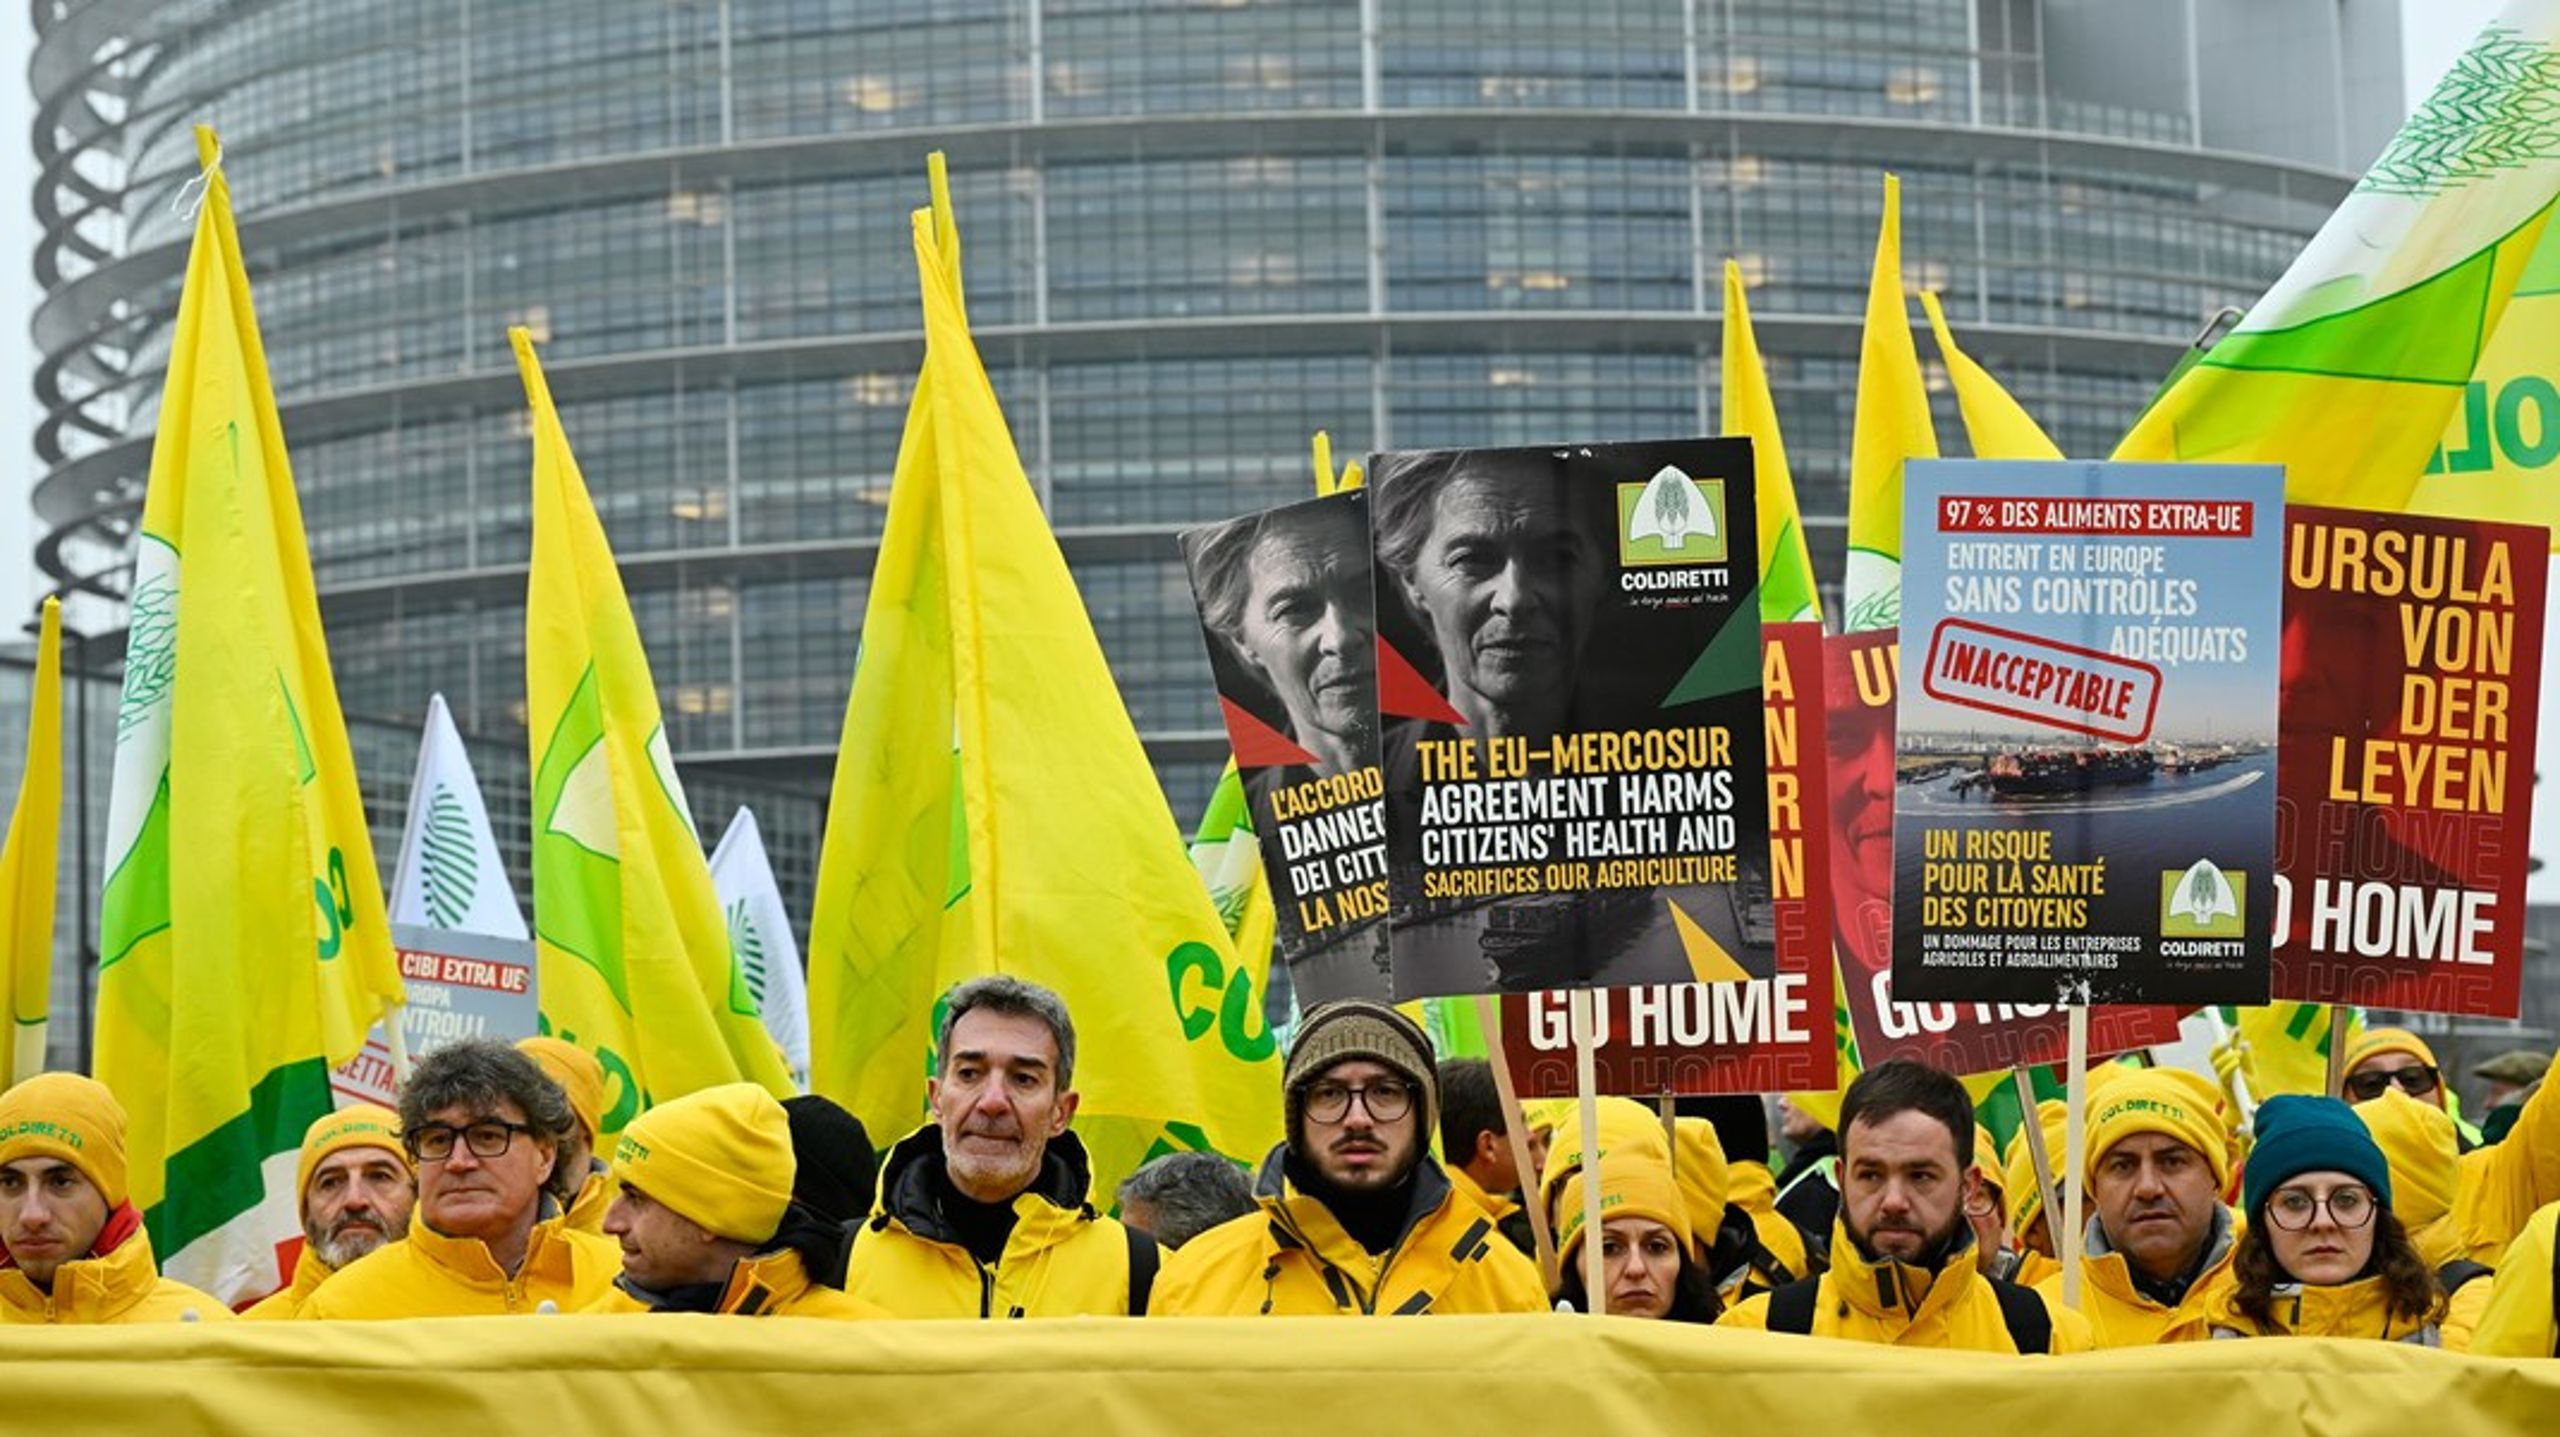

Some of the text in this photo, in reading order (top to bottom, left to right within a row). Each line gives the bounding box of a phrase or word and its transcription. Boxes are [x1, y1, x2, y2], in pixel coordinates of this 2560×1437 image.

[1946, 500, 2242, 532] 97 % DES ALIMENTS EXTRA-UE
[1621, 568, 1729, 591] COLDIRETTI
[1948, 542, 2165, 575] ENTRENT EN EUROPE
[2289, 522, 2516, 607] URSULA
[1944, 569, 2198, 617] SANS CONTRÔLES
[2108, 616, 2249, 668] ADÉQUATS
[2400, 602, 2516, 676] VON
[1940, 639, 2136, 721] INACCEPTABLE
[2400, 673, 2510, 744] DER
[1415, 739, 1478, 782] THE
[2329, 735, 2509, 815] LEYEN
[1269, 765, 1384, 822] L'ACCORD
[1420, 769, 1735, 826] AGREEMENT HARMS
[1421, 814, 1736, 866] CITIZENS' HEALTH AND
[1924, 829, 2052, 863] UN RISQUE
[1289, 858, 1332, 897] DEI
[1424, 854, 1738, 898] SACRIFICES OUR AGRICULTURE
[1923, 856, 2106, 896] POUR LA SANTÉ
[1299, 894, 1334, 933] LA
[1922, 896, 2088, 929] DES CITOYENS
[2310, 877, 2498, 966] HOME
[1921, 950, 2119, 969] AGRICOLES ET AGROALIMENTAIRES
[1922, 934, 2142, 952] UN DOMMAGE POUR LES ENTREPRISES
[2159, 940, 2246, 957] COLDIRETTI
[402, 952, 440, 979] CIBI
[441, 958, 497, 988] EXTRA
[501, 965, 525, 991] UE
[1628, 972, 1812, 1048] HOME
